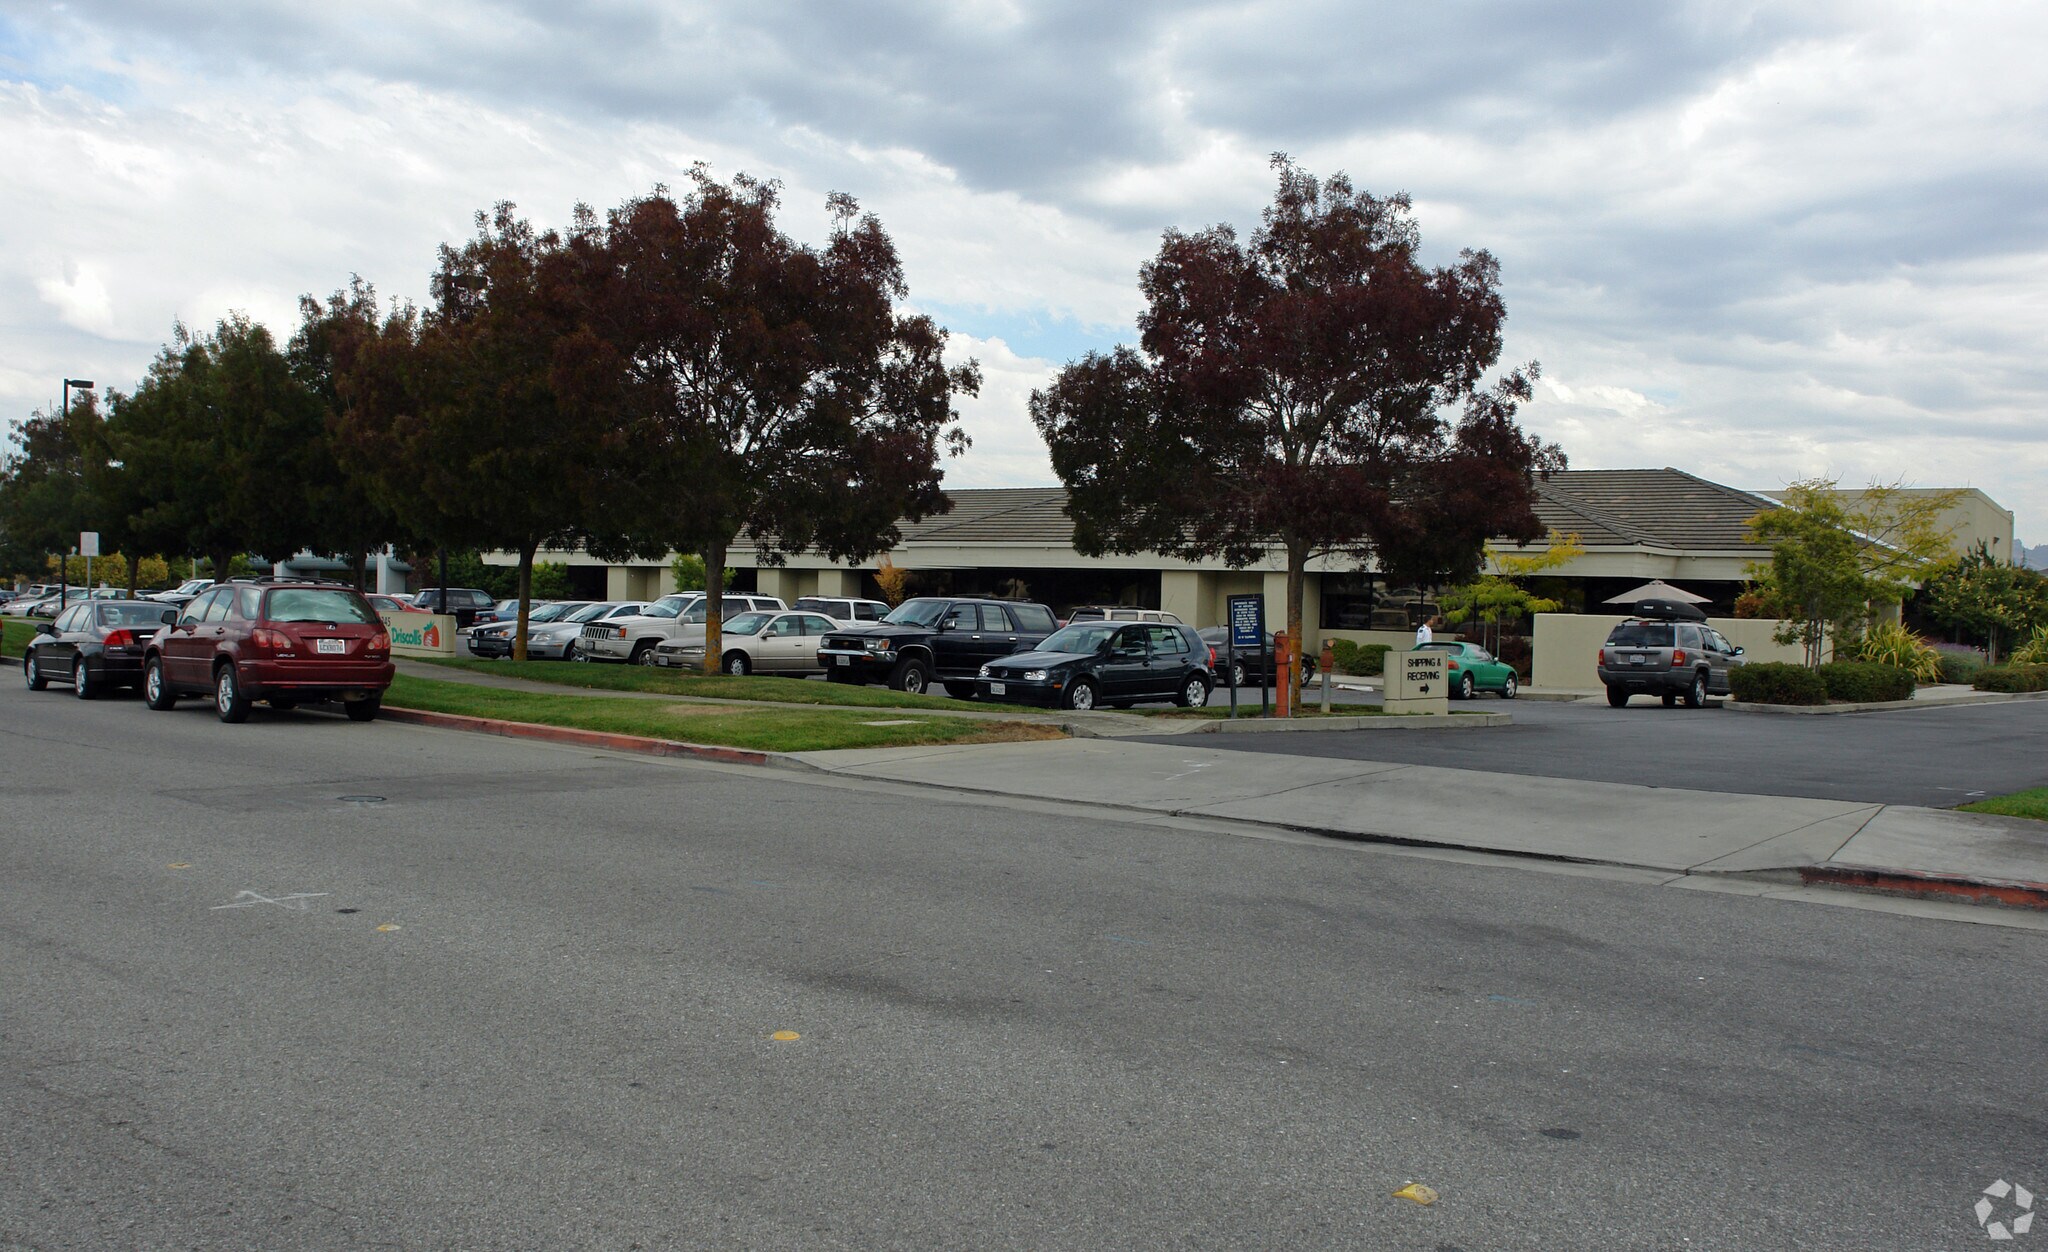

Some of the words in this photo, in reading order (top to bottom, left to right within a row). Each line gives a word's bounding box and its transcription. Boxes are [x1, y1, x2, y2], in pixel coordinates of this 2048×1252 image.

[1408, 658, 1435, 667] SHIPPING
[1437, 658, 1441, 666] &
[1407, 671, 1440, 681] RECEIVING
